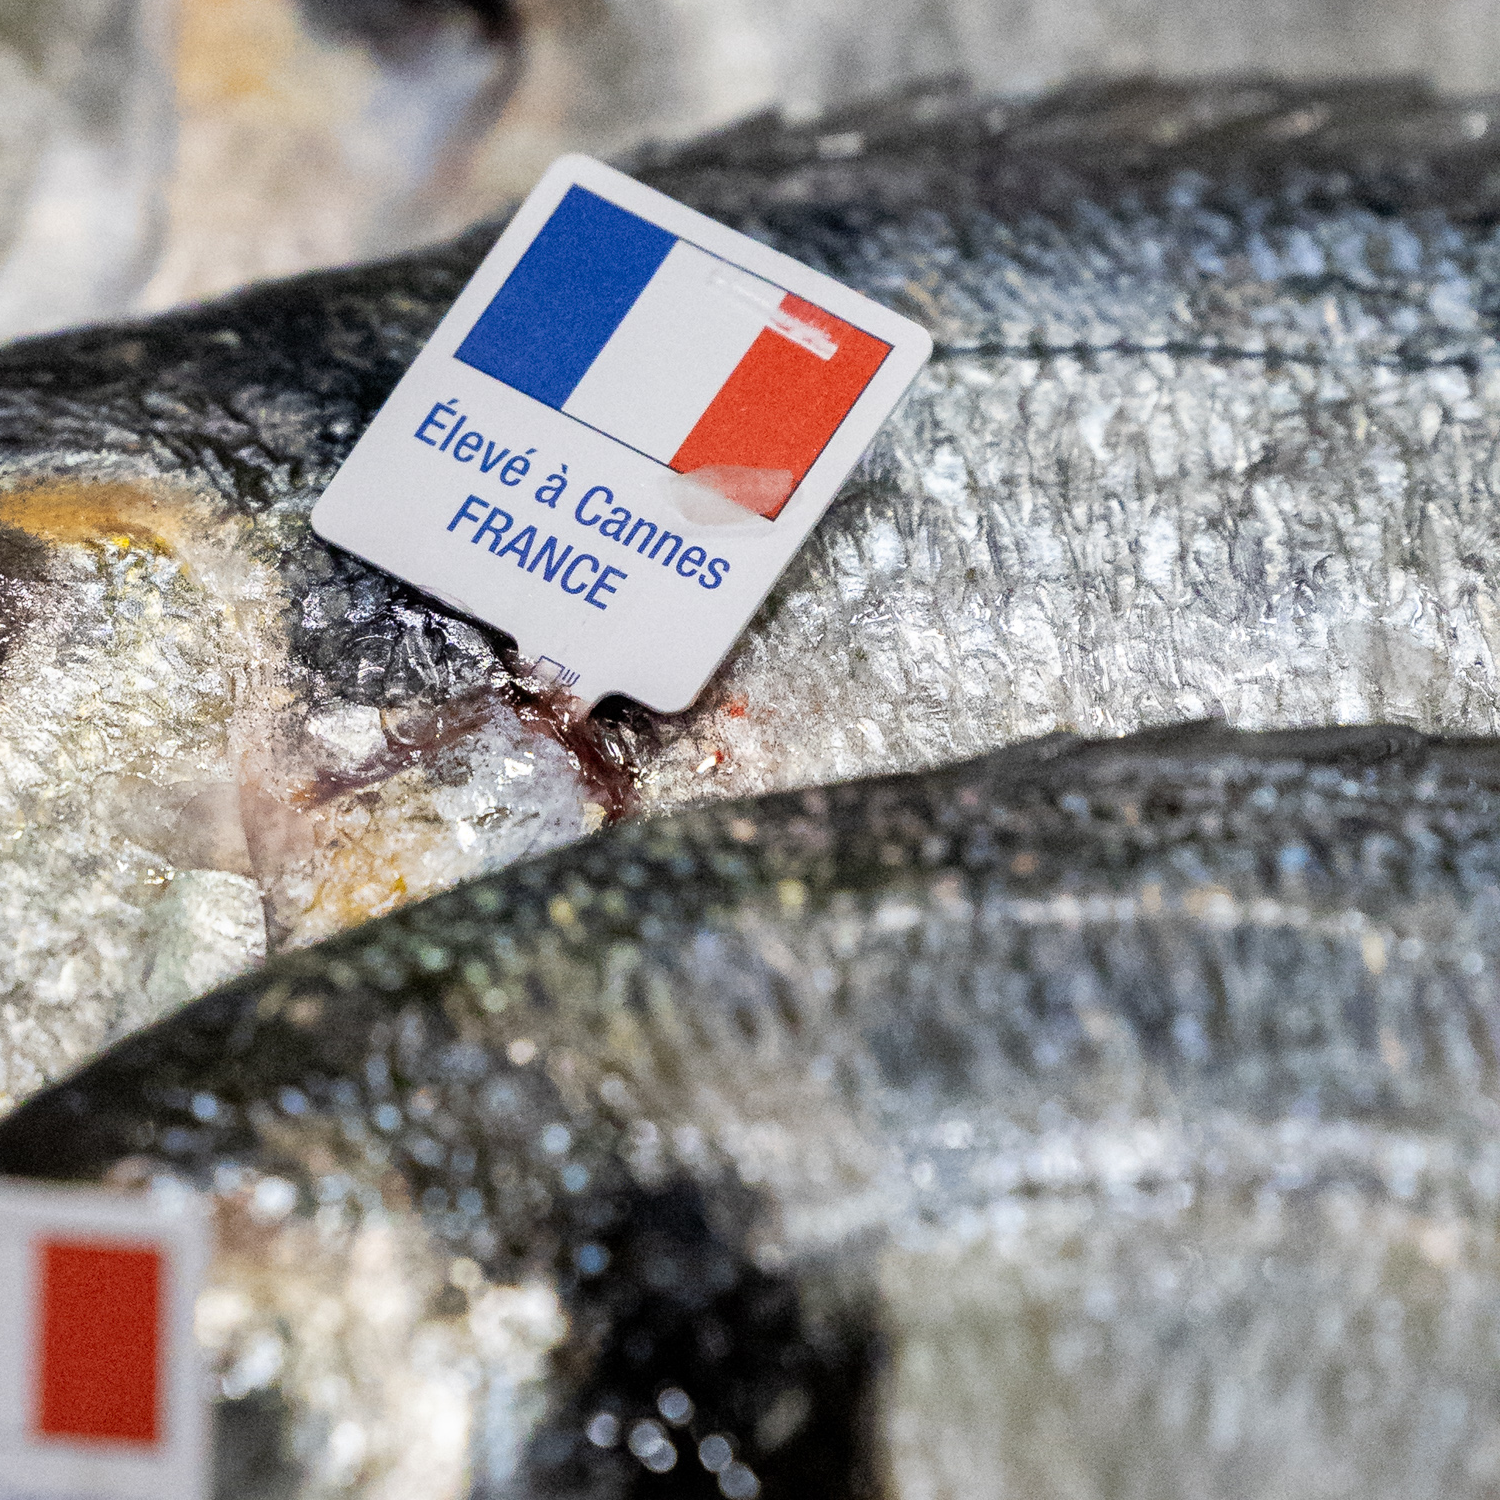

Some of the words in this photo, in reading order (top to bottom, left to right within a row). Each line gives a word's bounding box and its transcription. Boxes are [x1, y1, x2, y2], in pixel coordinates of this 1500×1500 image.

[413, 398, 537, 486] Élevé
[534, 463, 568, 509] à
[574, 485, 731, 590] Cannes
[446, 494, 628, 610] FRANCE
